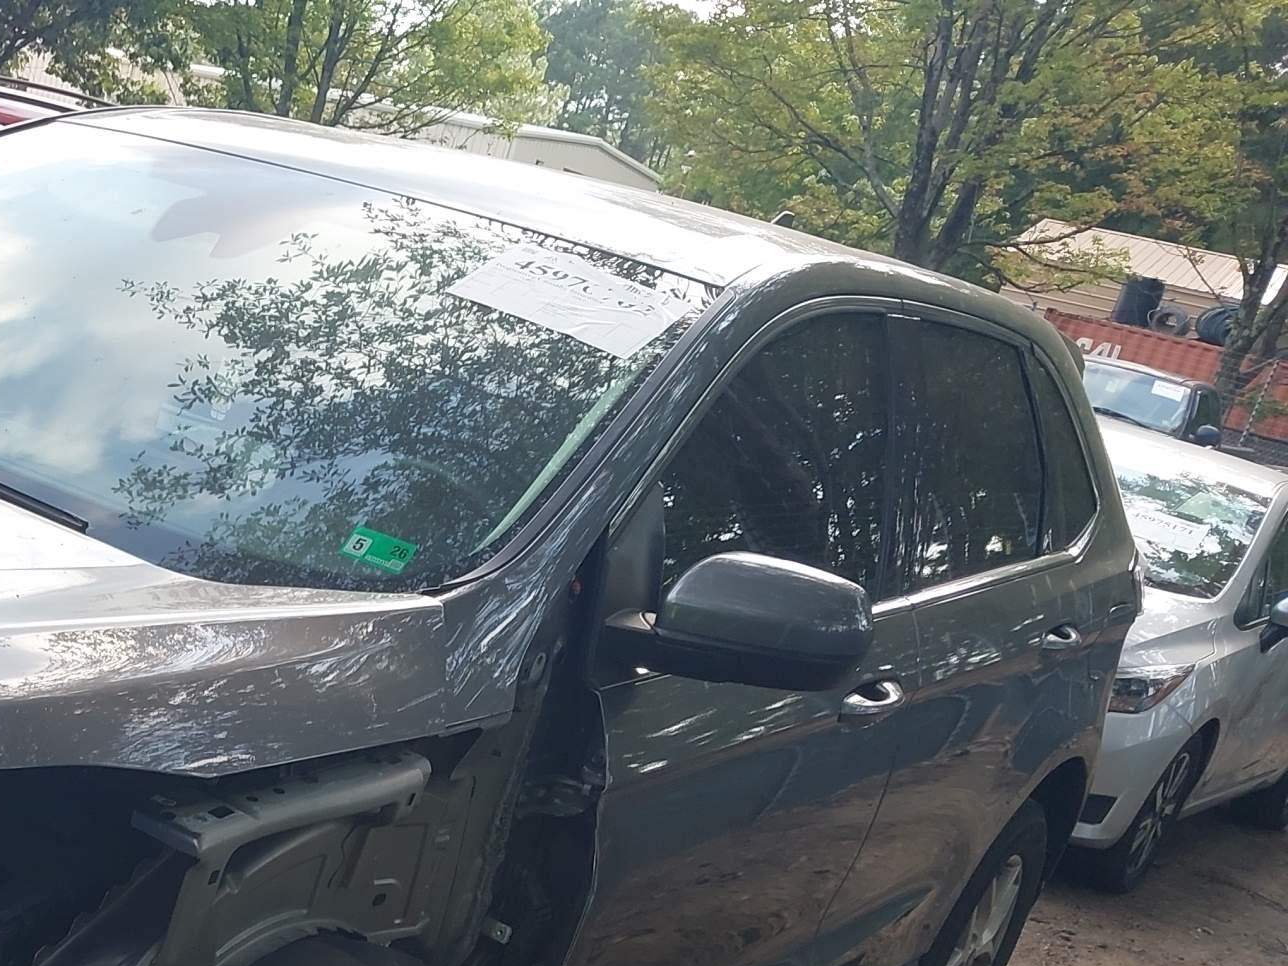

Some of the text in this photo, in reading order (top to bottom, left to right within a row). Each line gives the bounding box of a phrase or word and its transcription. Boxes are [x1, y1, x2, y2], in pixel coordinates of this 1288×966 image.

[514, 260, 656, 317] 459702
[352, 537, 367, 551] 5
[390, 545, 410, 559] 26
